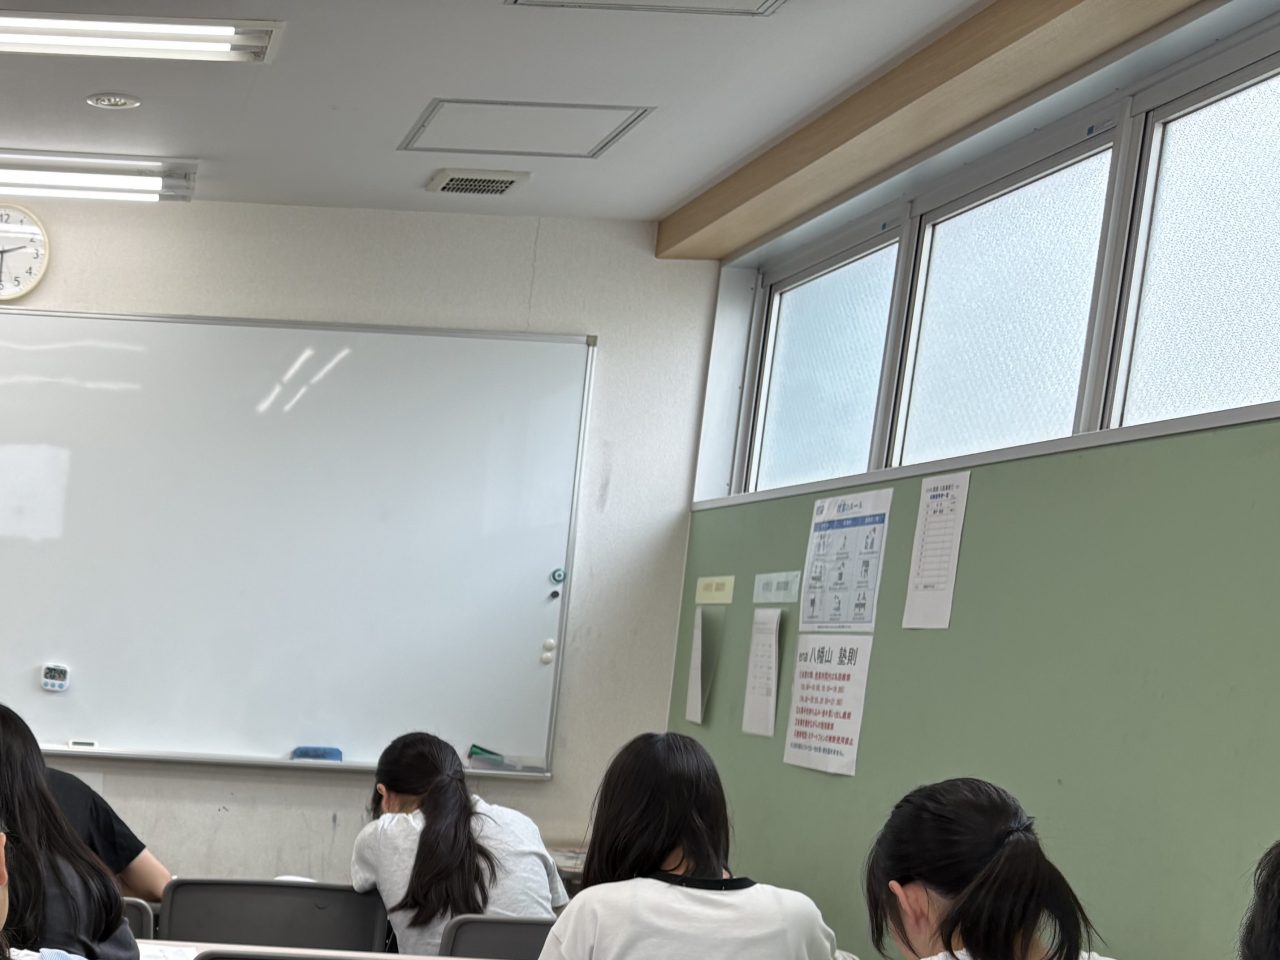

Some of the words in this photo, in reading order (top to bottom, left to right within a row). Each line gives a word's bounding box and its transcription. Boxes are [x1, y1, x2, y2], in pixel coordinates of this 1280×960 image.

[0, 213, 10, 224] 12
[33, 249, 39, 259] 3
[25, 266, 32, 276] 4
[14, 277, 20, 287] 5
[809, 646, 833, 664] 八幡山
[837, 646, 859, 666] 塾則
